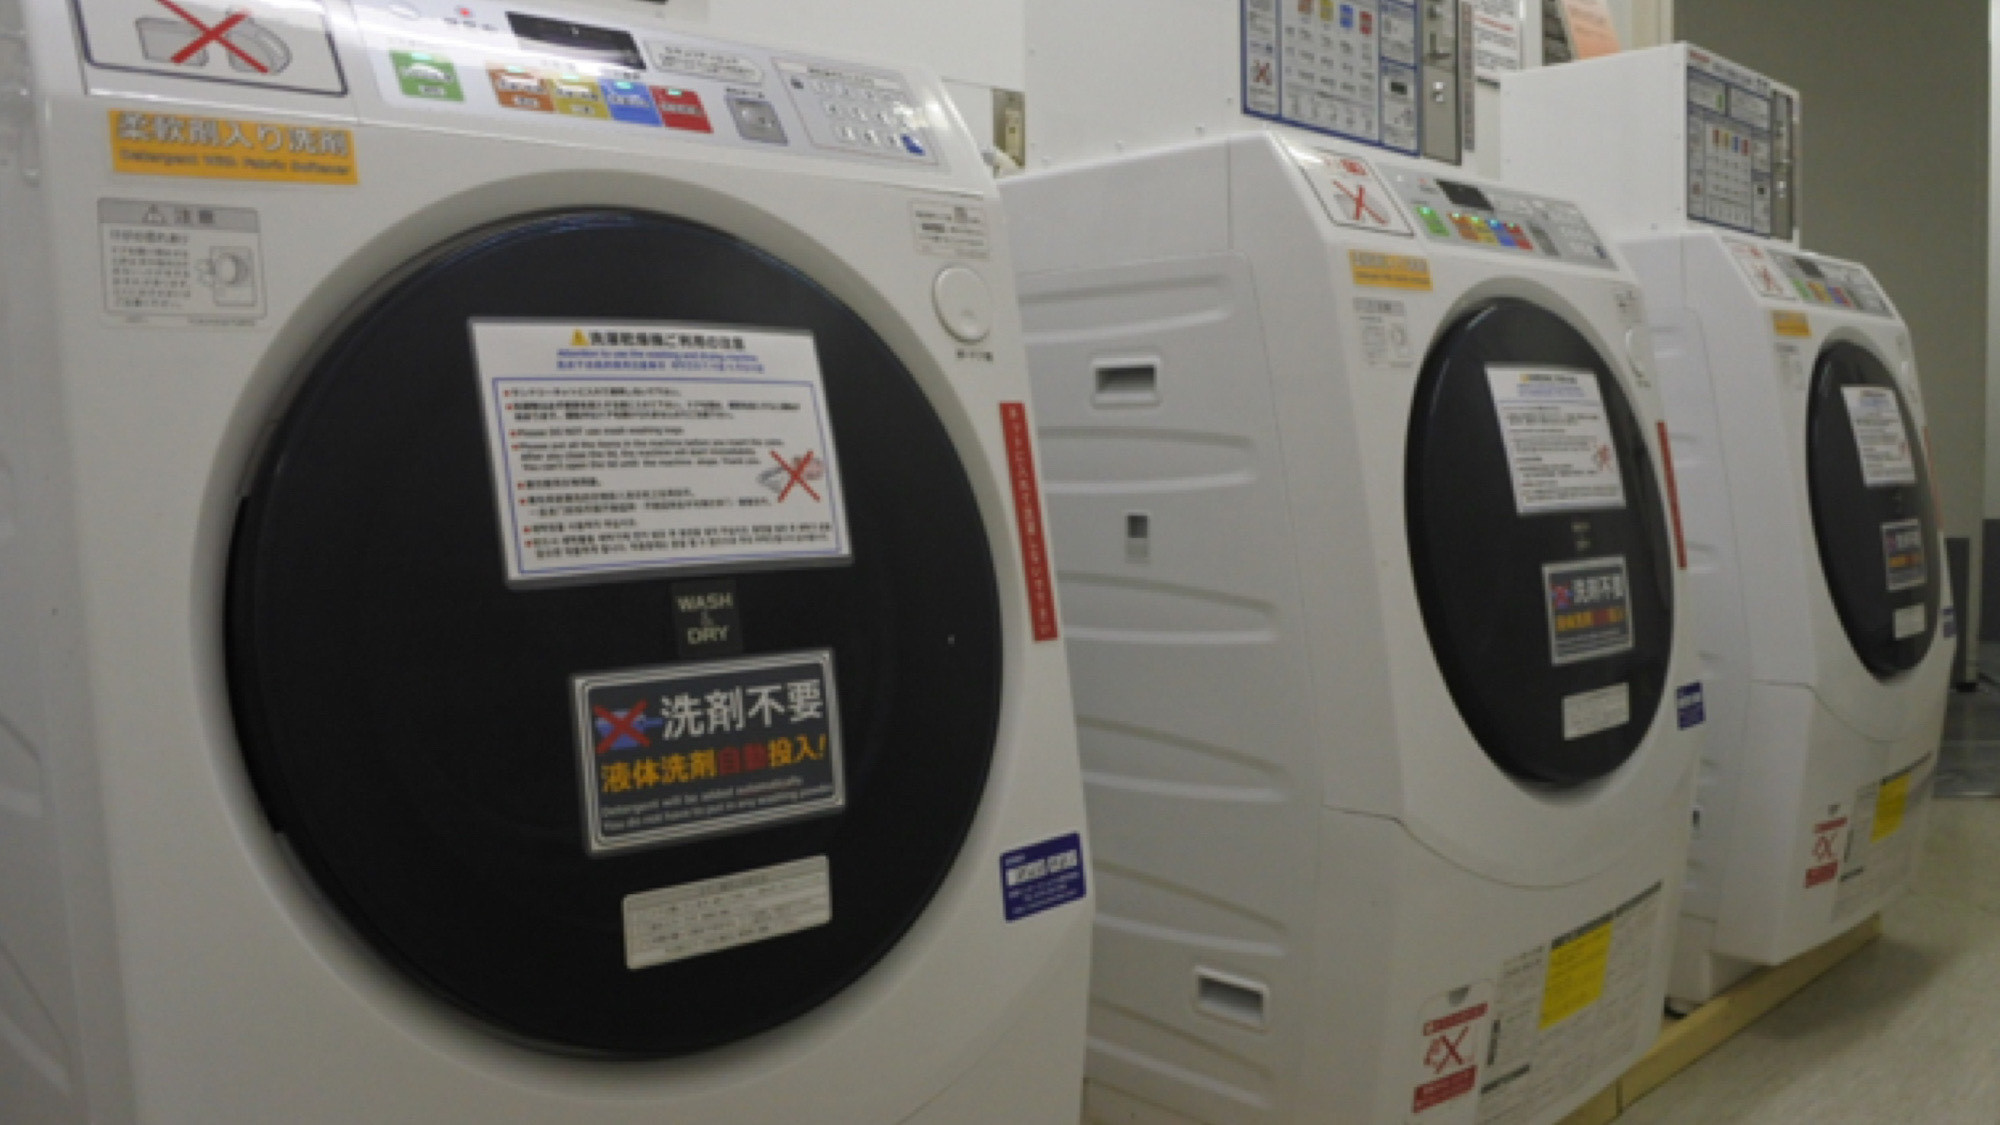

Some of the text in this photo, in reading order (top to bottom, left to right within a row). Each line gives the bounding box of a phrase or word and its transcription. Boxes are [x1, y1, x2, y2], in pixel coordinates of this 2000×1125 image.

[118, 111, 348, 157] 柔軟剤入り洗剤
[677, 593, 734, 613] WASH
[687, 625, 730, 645] DRY
[659, 679, 825, 741] 洗剤不要
